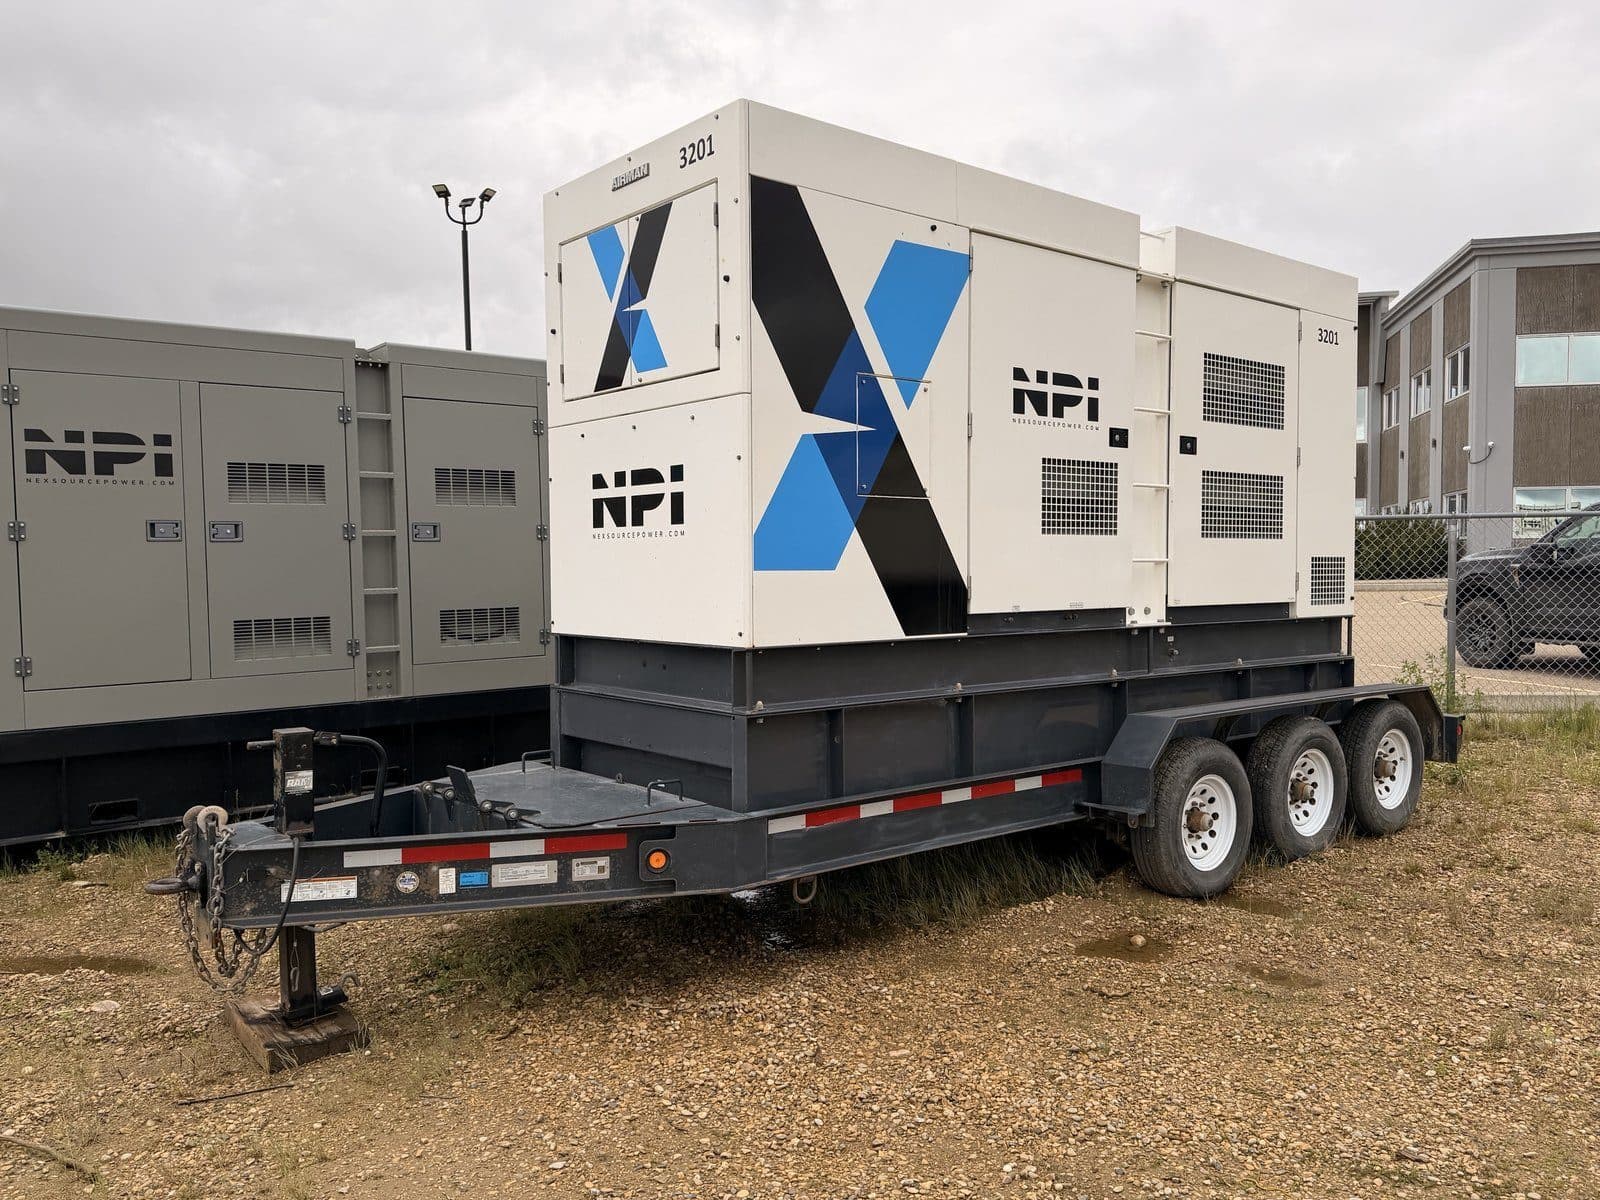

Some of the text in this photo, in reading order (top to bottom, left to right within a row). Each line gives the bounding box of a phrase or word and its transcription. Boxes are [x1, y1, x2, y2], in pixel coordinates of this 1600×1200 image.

[679, 133, 715, 169] 3201
[611, 162, 650, 192] AIRMAN
[1317, 327, 1339, 345] 3201
[1012, 418, 1100, 431] NEXSOURCEPOWER.COM
[25, 478, 175, 486] NEXSOURCEPOWER.COM
[592, 530, 685, 539] NEXSOURCEPOWER.COM
